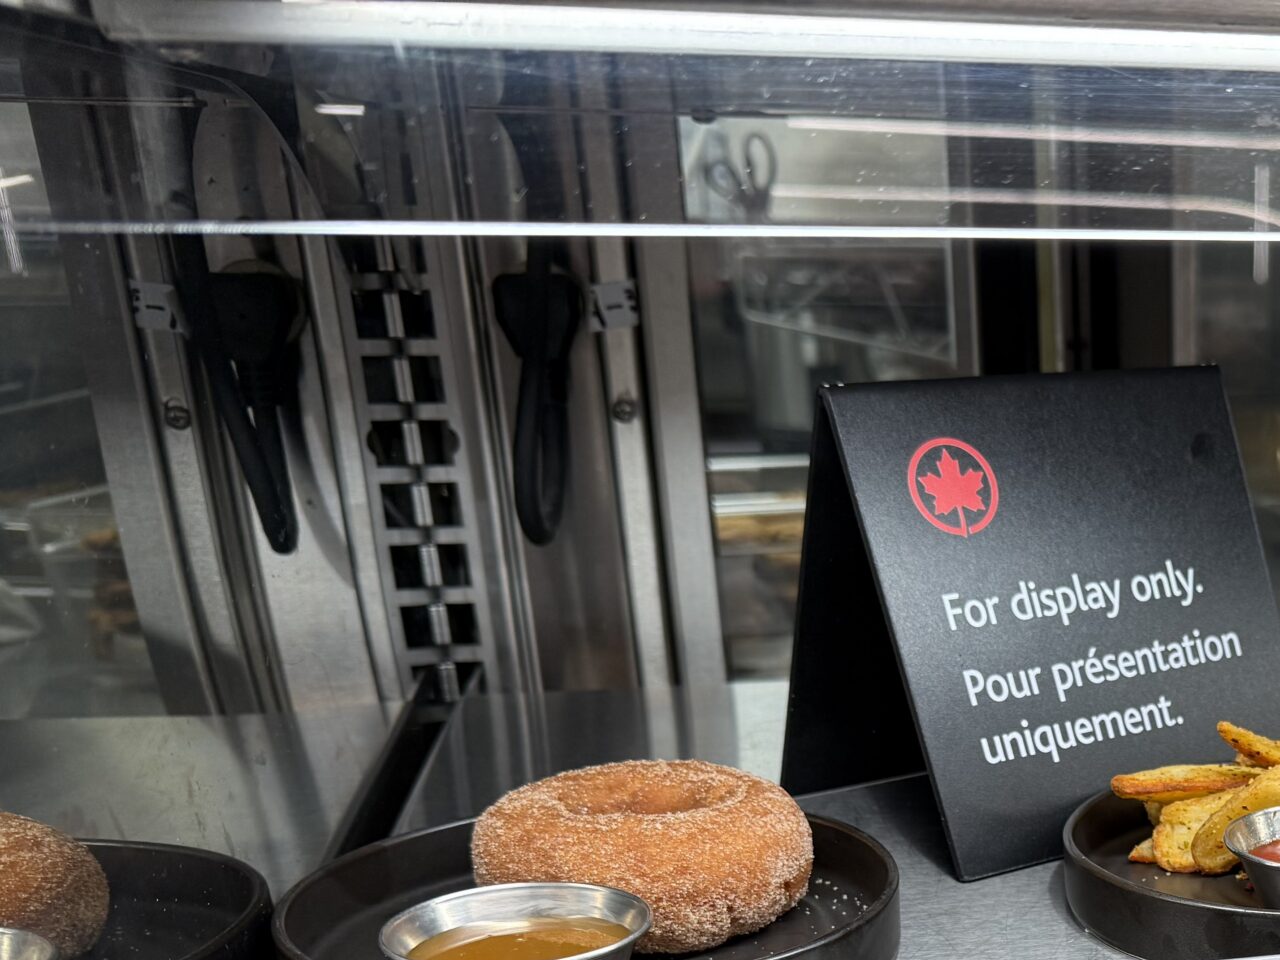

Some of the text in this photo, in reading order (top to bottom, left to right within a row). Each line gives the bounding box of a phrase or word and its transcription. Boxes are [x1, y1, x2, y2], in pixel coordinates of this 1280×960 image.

[942, 559, 1204, 631] For display only.
[962, 629, 1243, 707] Pour présentation
[980, 695, 1184, 765] uniquement.
